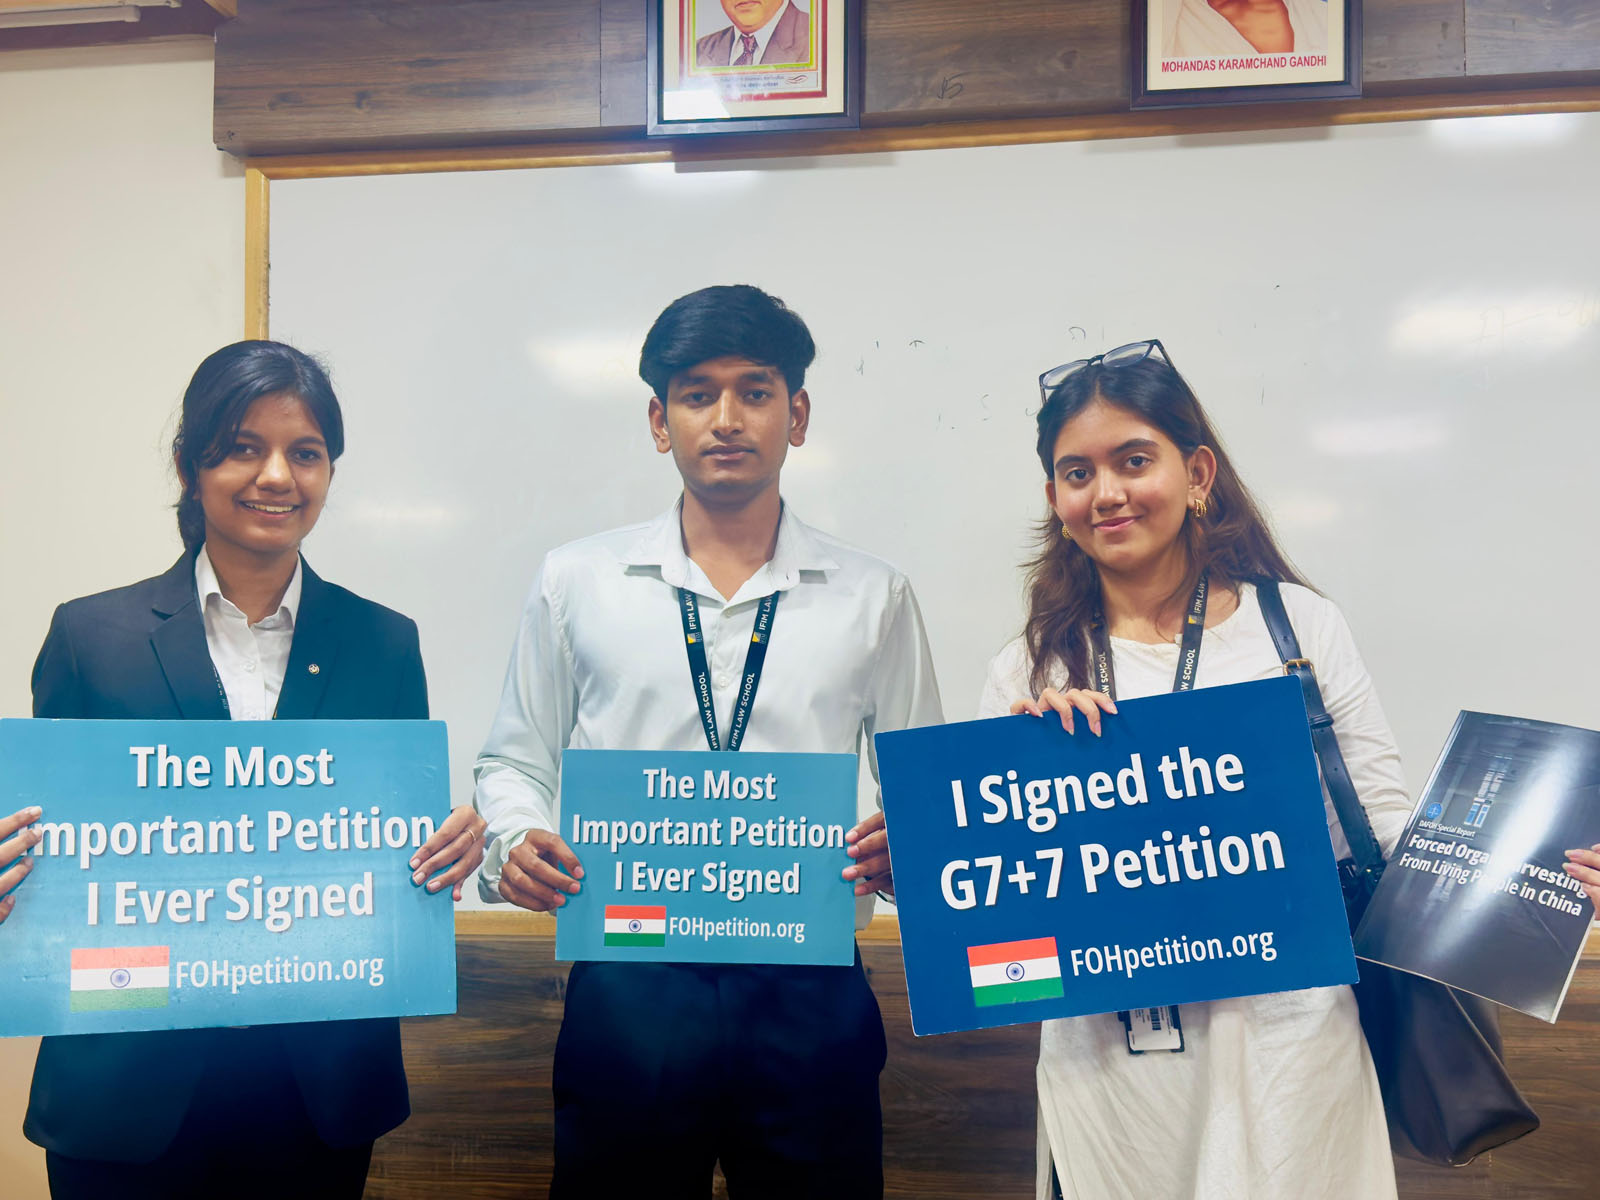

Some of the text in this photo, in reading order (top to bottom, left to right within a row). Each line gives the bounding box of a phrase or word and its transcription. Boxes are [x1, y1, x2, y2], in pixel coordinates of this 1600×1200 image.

[1161, 55, 1327, 73] MOHANDAS KARAMCHAND GANDHI
[687, 613, 697, 630] IFIM
[758, 613, 769, 631] IFIM
[1183, 648, 1196, 681] SCHOOL
[698, 671, 710, 708] SCHOOL
[705, 709, 714, 730] LAW
[731, 672, 756, 748] IFIM LAW SCHOOL
[129, 744, 334, 787] The Most
[643, 767, 776, 800] The Most
[951, 746, 1245, 833] I Signed the
[267, 806, 435, 852] Petition
[572, 814, 845, 853] Important Petition
[1437, 824, 1457, 833] Special
[1456, 828, 1476, 837] Report
[615, 861, 800, 901] I Ever Signed
[940, 825, 1286, 910] G7+7 Petition
[1399, 853, 1431, 872] From
[1431, 860, 1471, 885] Living
[1519, 882, 1536, 901] in
[1538, 889, 1583, 917] China
[1408, 833, 1456, 856] Forced
[1511, 861, 1588, 899] rvesting
[87, 872, 374, 932] I Ever Signed
[669, 916, 805, 943] FOHpetition.org
[175, 954, 384, 994] FOHpetition.org
[1071, 931, 1278, 978] FOHpetition.org
